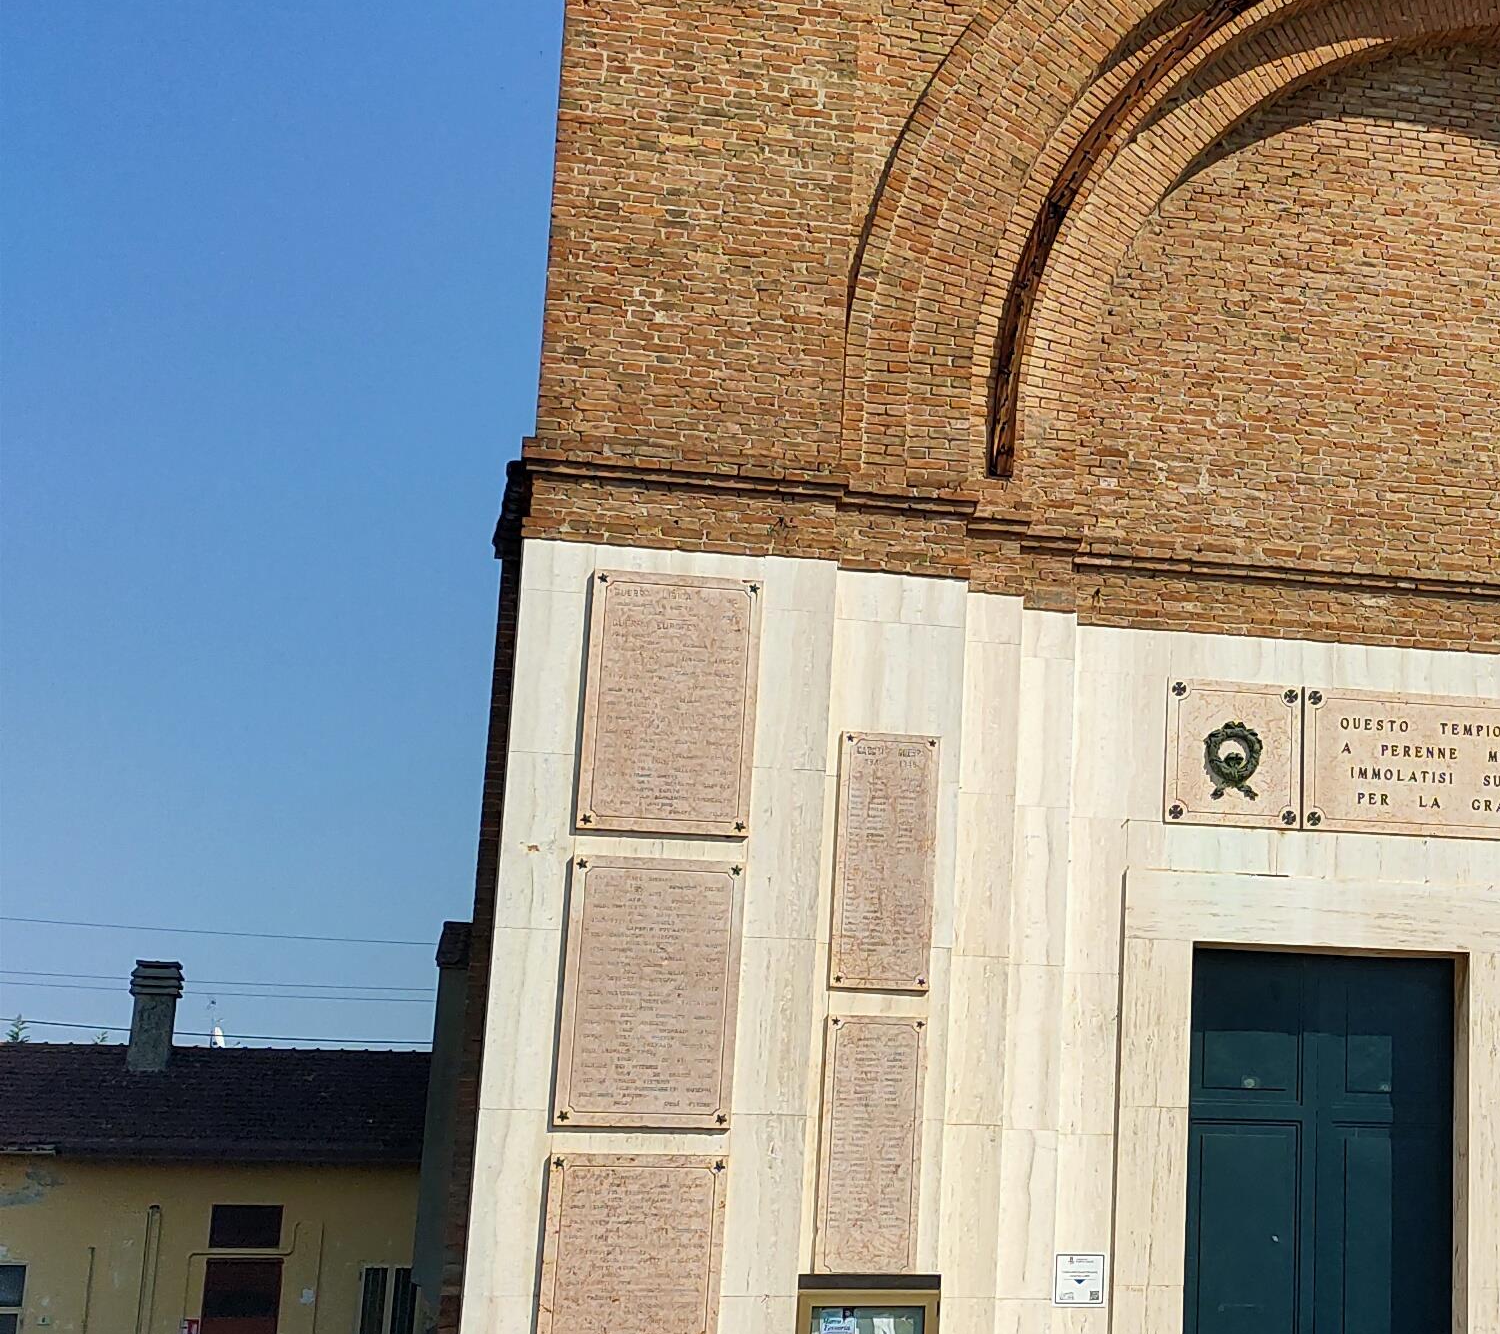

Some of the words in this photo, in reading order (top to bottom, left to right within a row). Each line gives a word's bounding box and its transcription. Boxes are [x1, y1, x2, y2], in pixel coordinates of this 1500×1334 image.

[1340, 717, 1409, 733] QUESTO
[1341, 742, 1352, 754] A
[1381, 744, 1458, 760] PERENNE
[1350, 766, 1454, 785] IMMOLATISI
[1357, 792, 1389, 806] PER
[1419, 795, 1441, 808] LA
